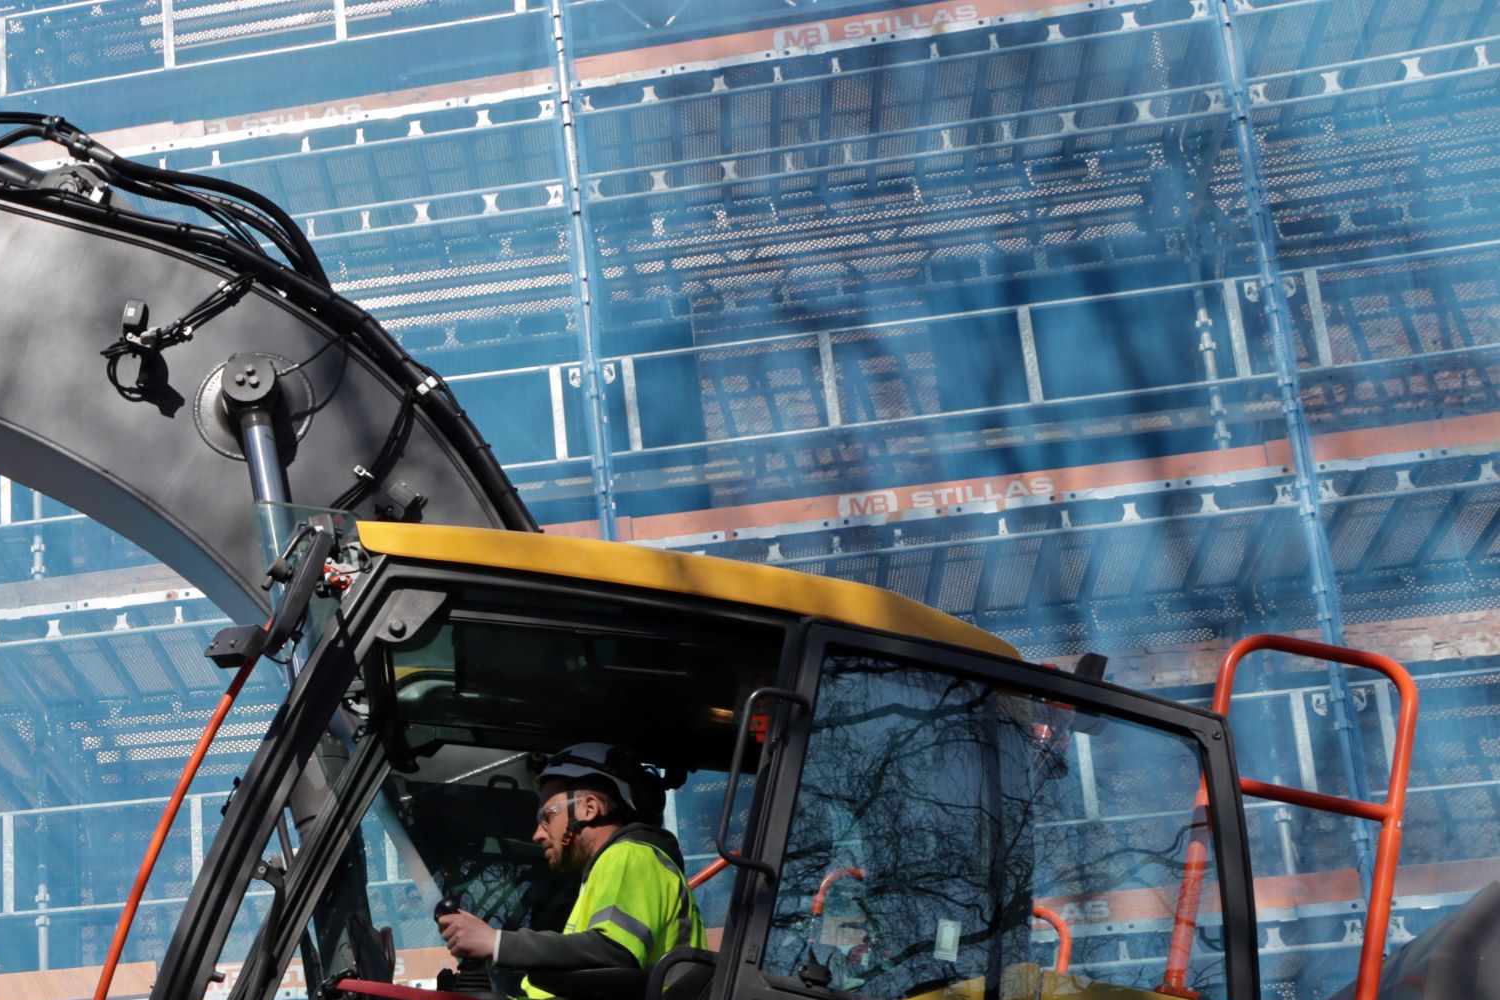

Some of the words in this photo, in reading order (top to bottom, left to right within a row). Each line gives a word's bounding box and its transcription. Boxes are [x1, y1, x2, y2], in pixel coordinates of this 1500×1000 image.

[843, 5, 978, 39] STILLAS
[849, 494, 893, 517] MB
[911, 477, 1054, 508] STILLAS
